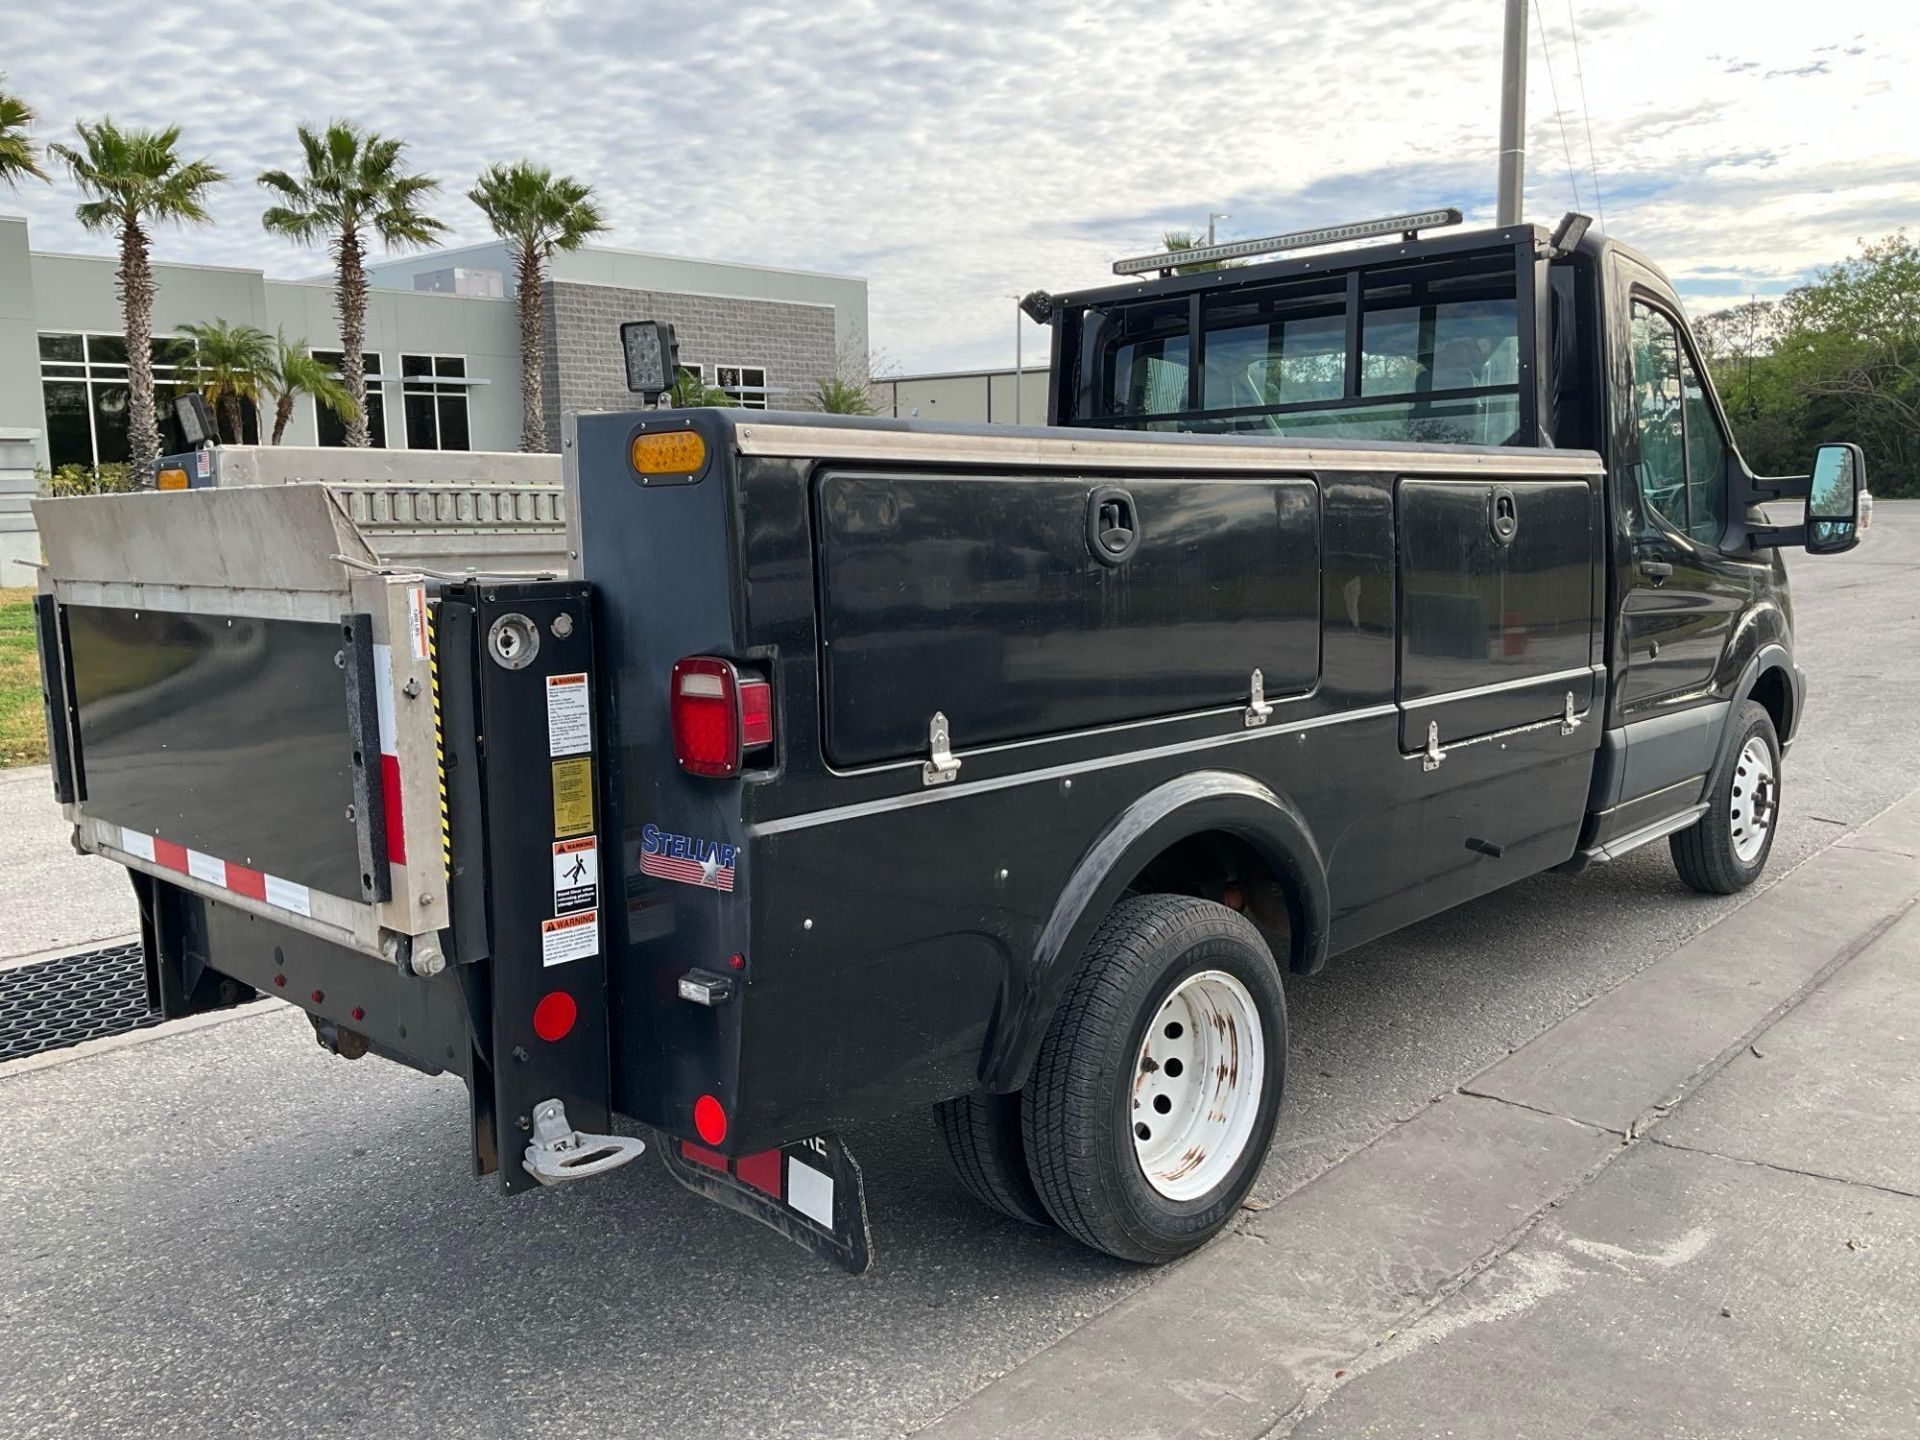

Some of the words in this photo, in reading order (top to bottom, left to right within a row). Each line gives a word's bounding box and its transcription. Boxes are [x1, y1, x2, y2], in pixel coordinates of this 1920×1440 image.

[566, 841, 593, 850] WARNING
[641, 823, 737, 869] STELLAR
[557, 913, 594, 929] WARNING
